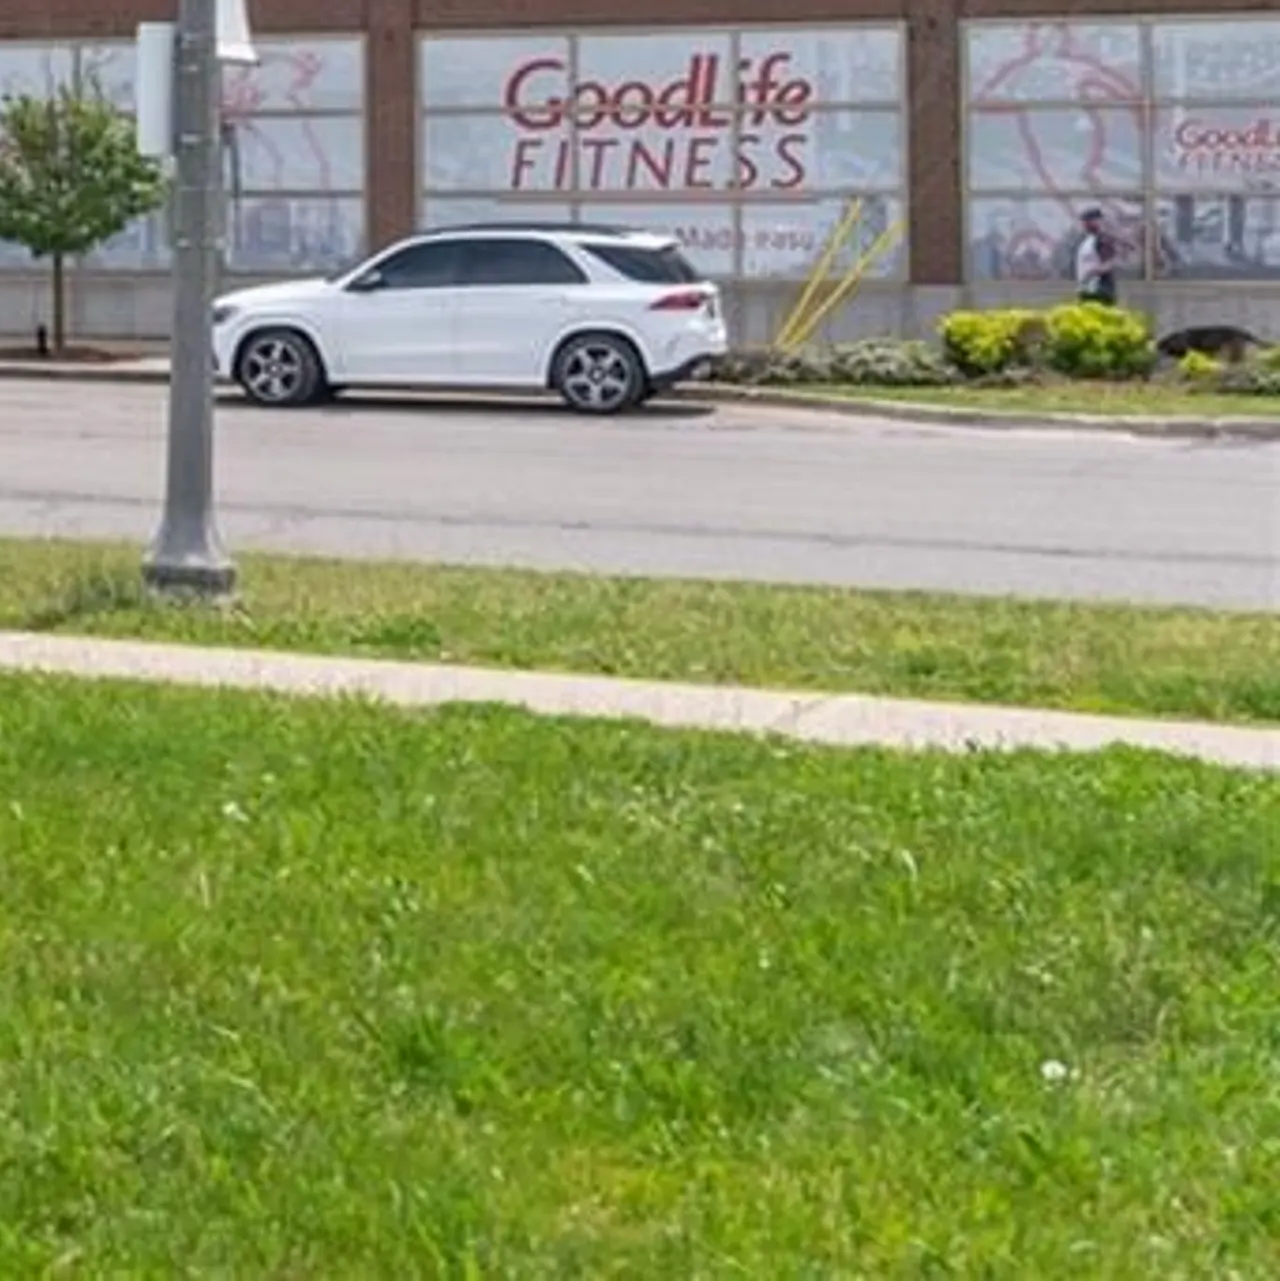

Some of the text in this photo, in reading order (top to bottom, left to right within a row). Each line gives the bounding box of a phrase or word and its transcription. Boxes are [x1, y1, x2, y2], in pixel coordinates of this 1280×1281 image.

[505, 53, 814, 131] GoodLife
[1175, 118, 1280, 149] GoodL
[511, 134, 810, 189] FITNESS
